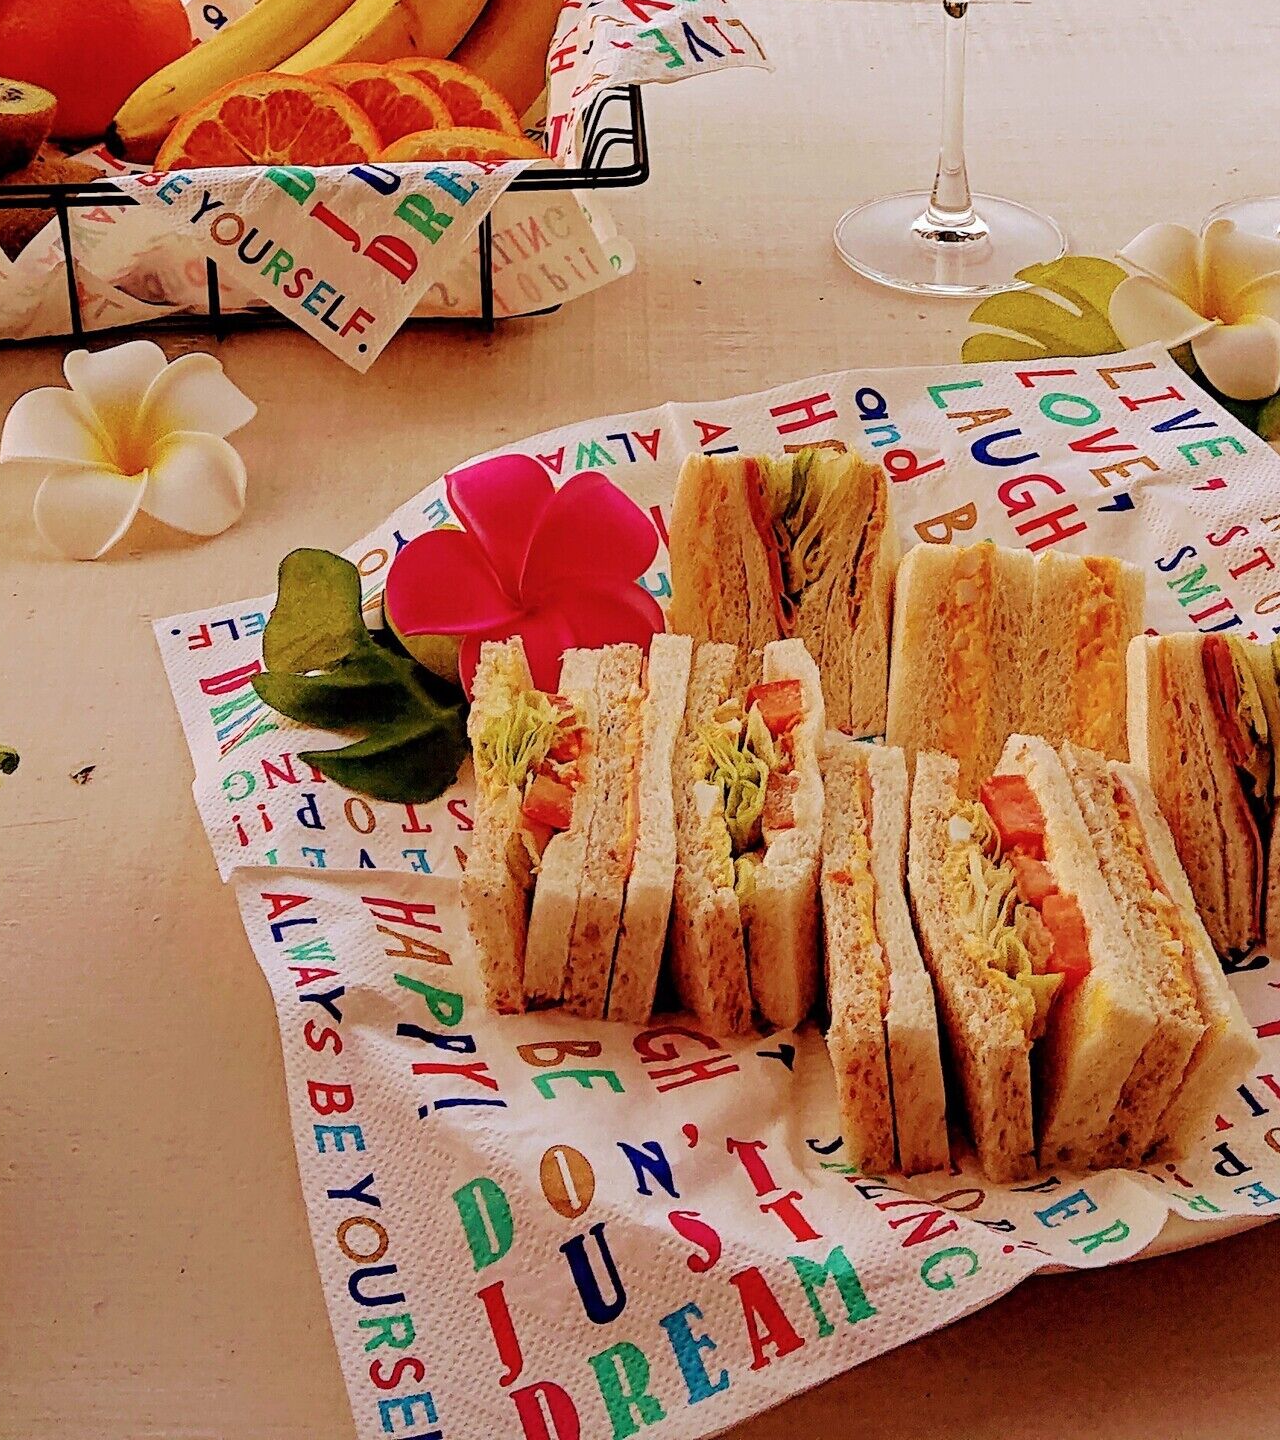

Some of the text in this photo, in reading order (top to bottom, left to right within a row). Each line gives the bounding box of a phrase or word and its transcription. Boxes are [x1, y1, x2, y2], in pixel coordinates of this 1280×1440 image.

[189, 190, 376, 354] YOURSELF.
[855, 387, 946, 483] and
[926, 380, 1088, 553] LAUGH
[1014, 369, 1161, 512] LOVE,
[1096, 361, 1248, 492] LIVE,
[259, 891, 347, 1058] ALWAYS
[360, 894, 508, 1120] HAPPY!
[306, 1078, 367, 1155] BE
[516, 1040, 626, 1101] BE
[450, 1122, 783, 1272] DON'T
[325, 1172, 444, 1440] YOURSE
[474, 1190, 825, 1389] JUST
[508, 1244, 878, 1440] DREAM
